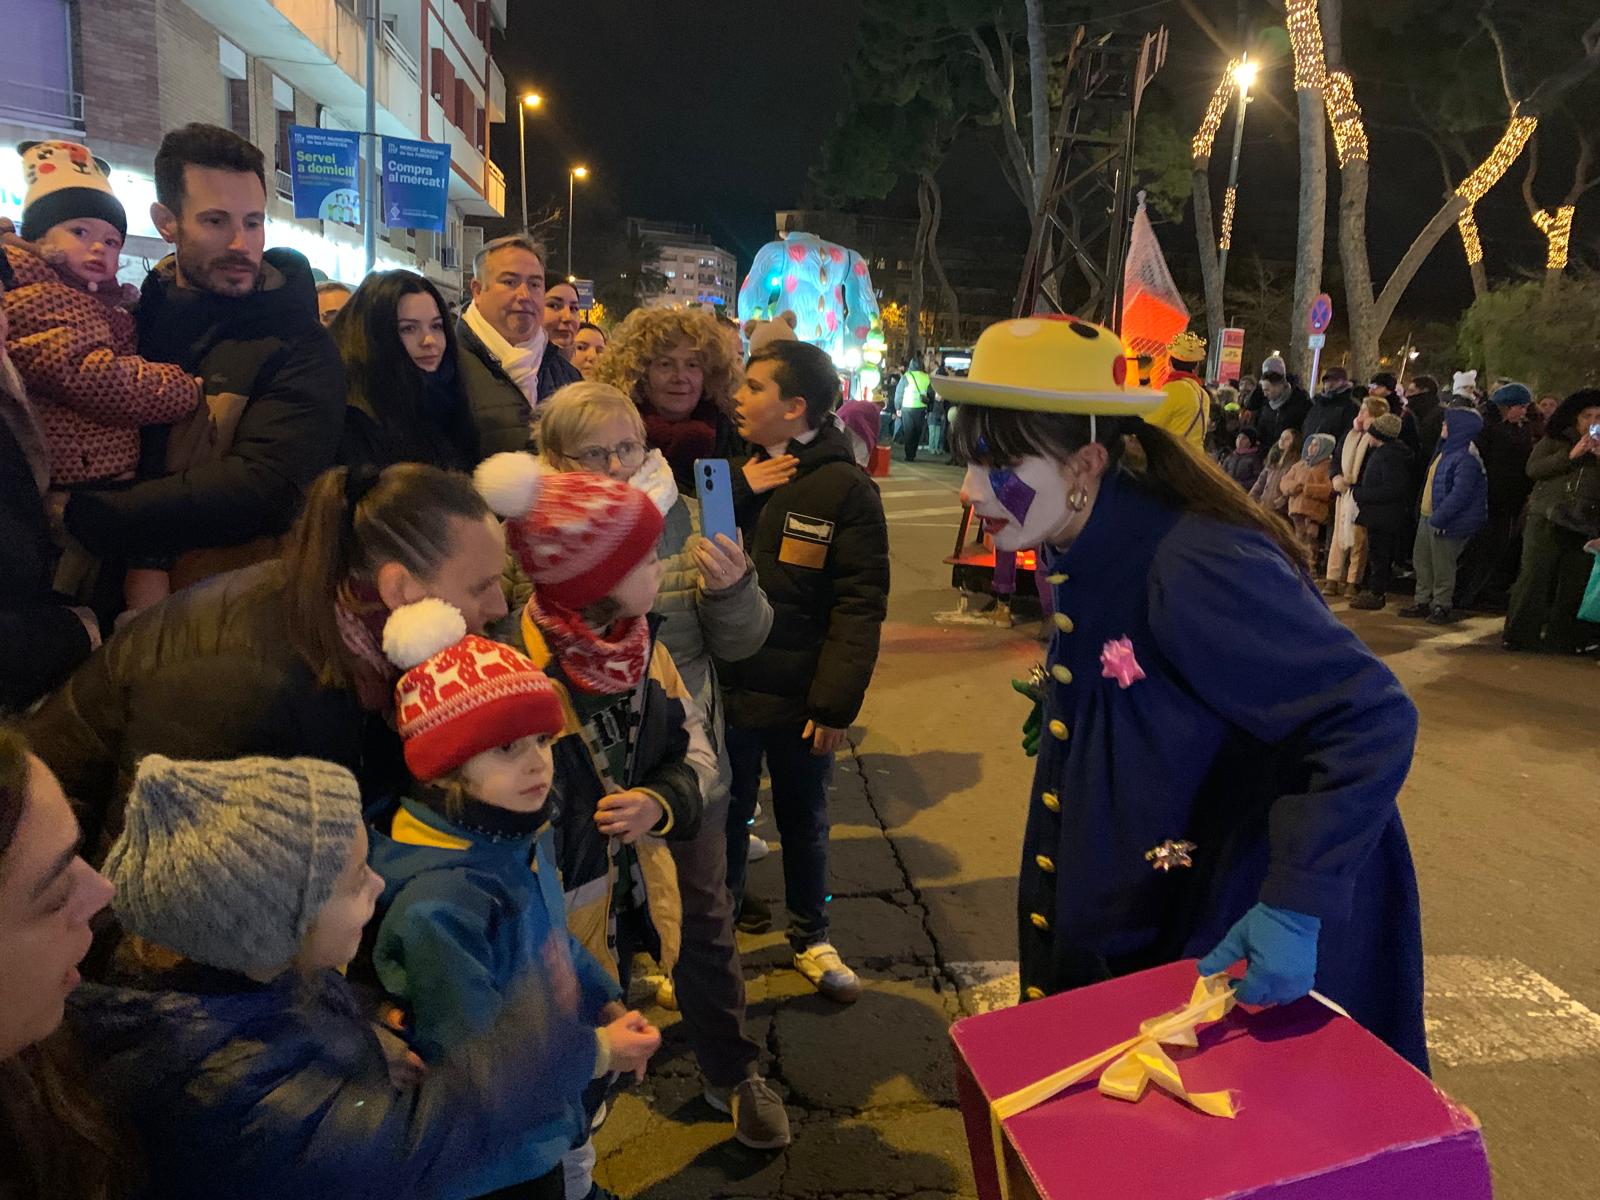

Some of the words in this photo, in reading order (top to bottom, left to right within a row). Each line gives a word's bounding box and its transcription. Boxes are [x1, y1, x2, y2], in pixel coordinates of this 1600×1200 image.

[296, 150, 336, 164] Servei
[297, 163, 305, 173] a
[307, 162, 355, 177] domicili
[388, 160, 433, 177] Compra
[388, 171, 399, 183] al
